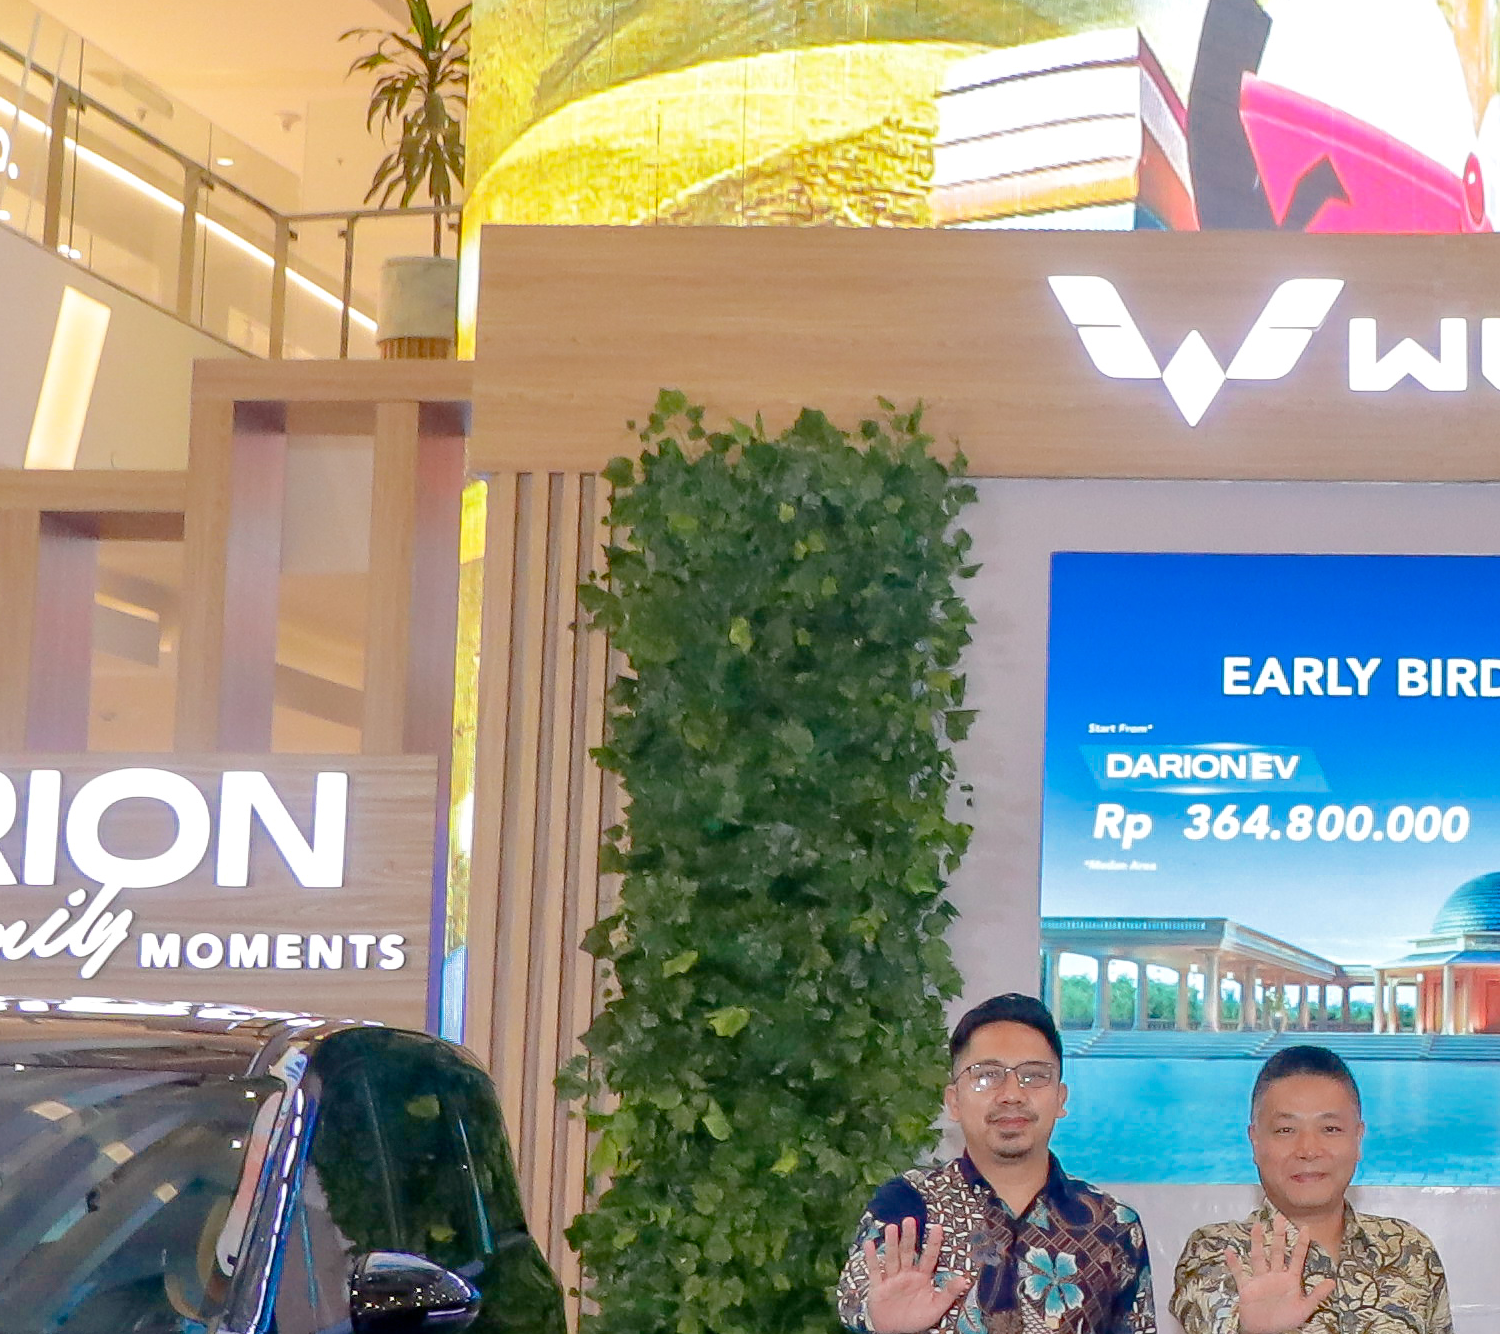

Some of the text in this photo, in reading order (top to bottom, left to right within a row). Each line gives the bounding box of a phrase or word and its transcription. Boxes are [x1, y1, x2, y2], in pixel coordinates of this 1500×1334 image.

[1222, 656, 1381, 697] EARLY
[1093, 803, 1470, 850] Rp 364.800.000
[139, 932, 406, 971] MOMENTS
